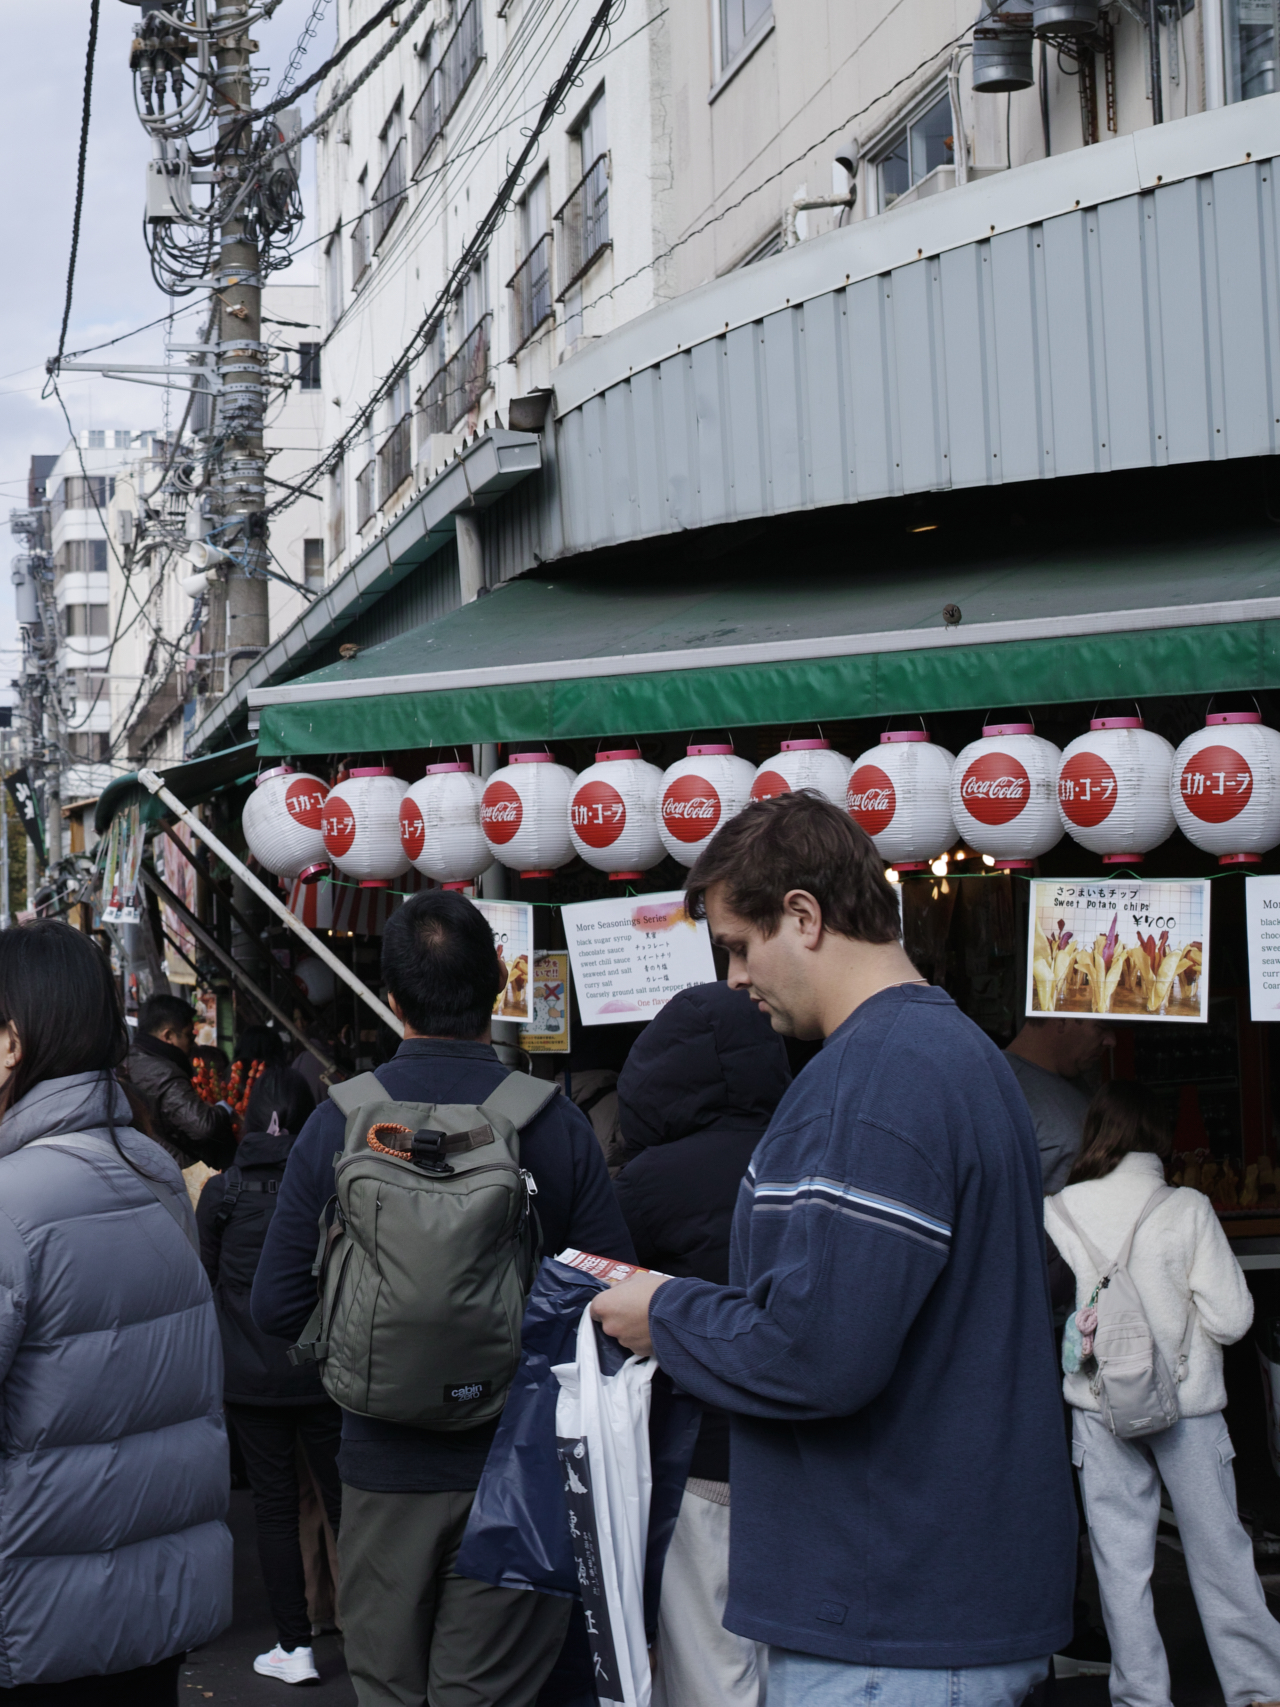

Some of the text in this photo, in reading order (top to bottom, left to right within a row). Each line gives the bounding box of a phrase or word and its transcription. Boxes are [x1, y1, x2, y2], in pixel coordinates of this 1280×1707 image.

[962, 776, 1028, 799] Coca-Cola
[1182, 772, 1252, 795] コカ・コーラ
[662, 797, 719, 820] Coca-Cola
[1056, 886, 1139, 899] さつまいもチップ
[1053, 897, 1080, 908] Sweet
[1123, 901, 1150, 912] chips
[576, 914, 667, 932] More Seasonings Series
[1132, 914, 1177, 929] ¥700
[594, 937, 611, 945] sugar
[613, 934, 632, 943] syrup
[635, 941, 670, 951] チョコレート
[578, 948, 606, 957] chocolate
[636, 952, 671, 961] スイートチリ
[580, 960, 597, 968] sweet
[598, 957, 611, 966] chili
[582, 970, 606, 978] seaweed
[608, 968, 619, 976] and
[584, 981, 600, 989] curry
[586, 989, 610, 999] Coarsely
[612, 988, 634, 997] ground
[635, 986, 647, 994] salt
[662, 983, 684, 992] pepper
[637, 999, 651, 1007] One
[451, 1383, 483, 1398] cabin
[457, 1391, 480, 1402] zero
